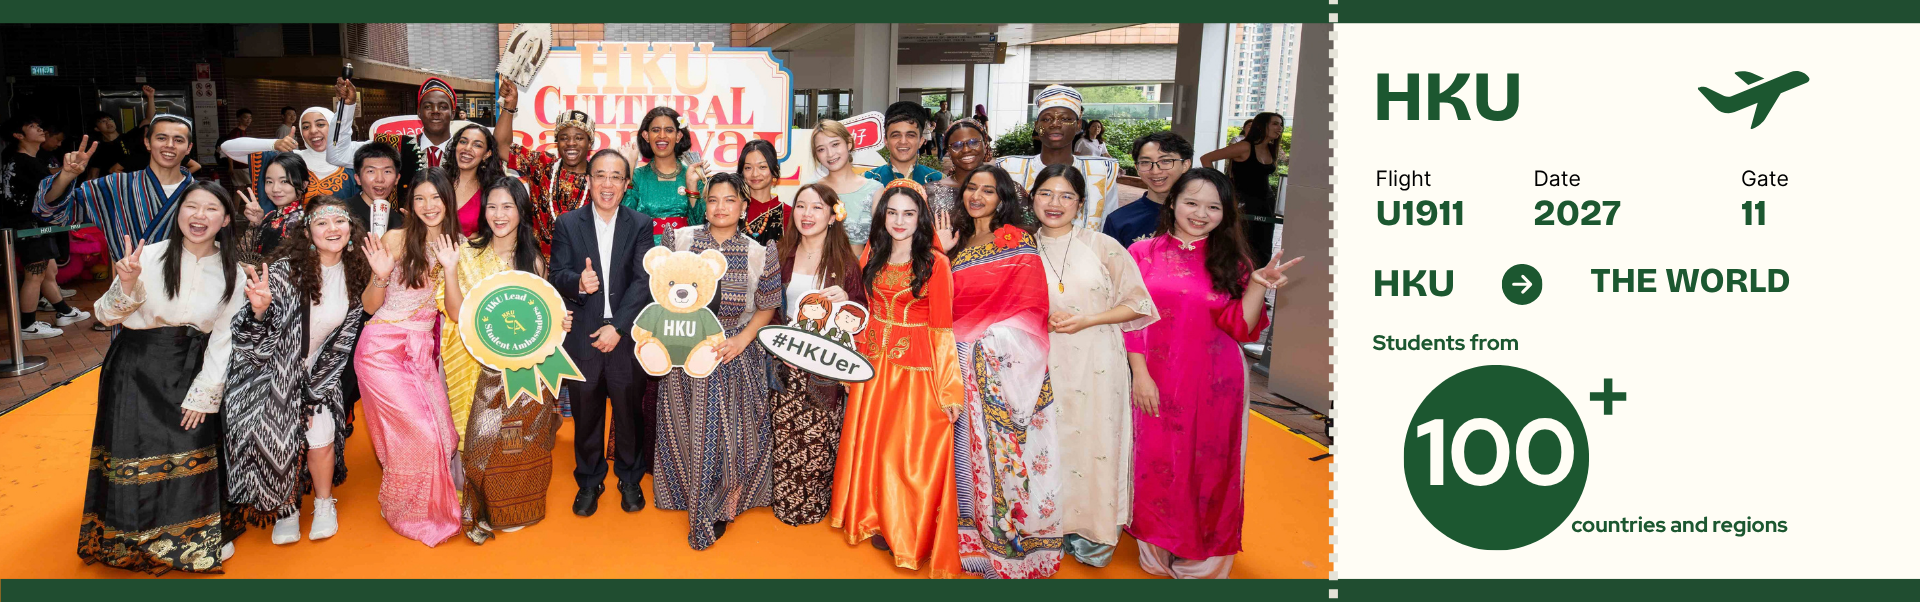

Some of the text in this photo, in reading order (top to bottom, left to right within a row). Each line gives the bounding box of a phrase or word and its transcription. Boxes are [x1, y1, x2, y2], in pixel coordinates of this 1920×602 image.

[575, 42, 715, 95] HKU
[534, 85, 755, 129] CULTURAL
[485, 293, 527, 312] HKU Lead
[485, 306, 543, 351] Student Ambassadors
[664, 320, 696, 337] HKU
[772, 332, 860, 375] #HKUer
